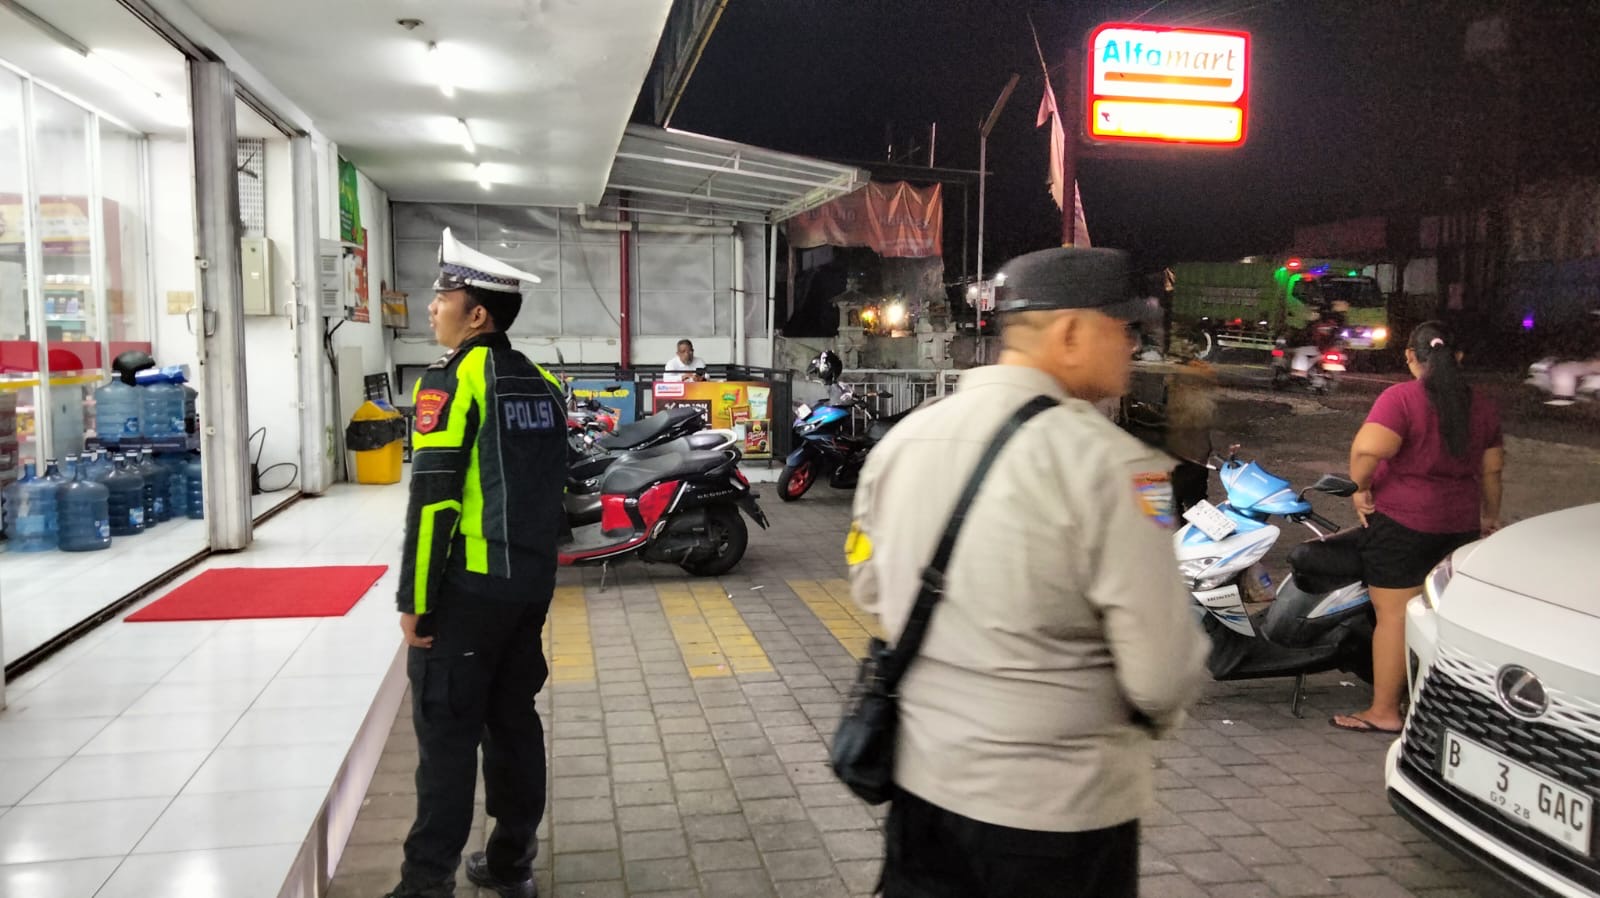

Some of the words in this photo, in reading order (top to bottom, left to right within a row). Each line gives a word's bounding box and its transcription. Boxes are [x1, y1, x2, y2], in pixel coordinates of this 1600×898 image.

[1102, 39, 1236, 72] Alfamart
[503, 401, 555, 430] POLISI
[1449, 739, 1461, 768] B
[1496, 761, 1510, 793] 3
[1537, 783, 1584, 831] GAC
